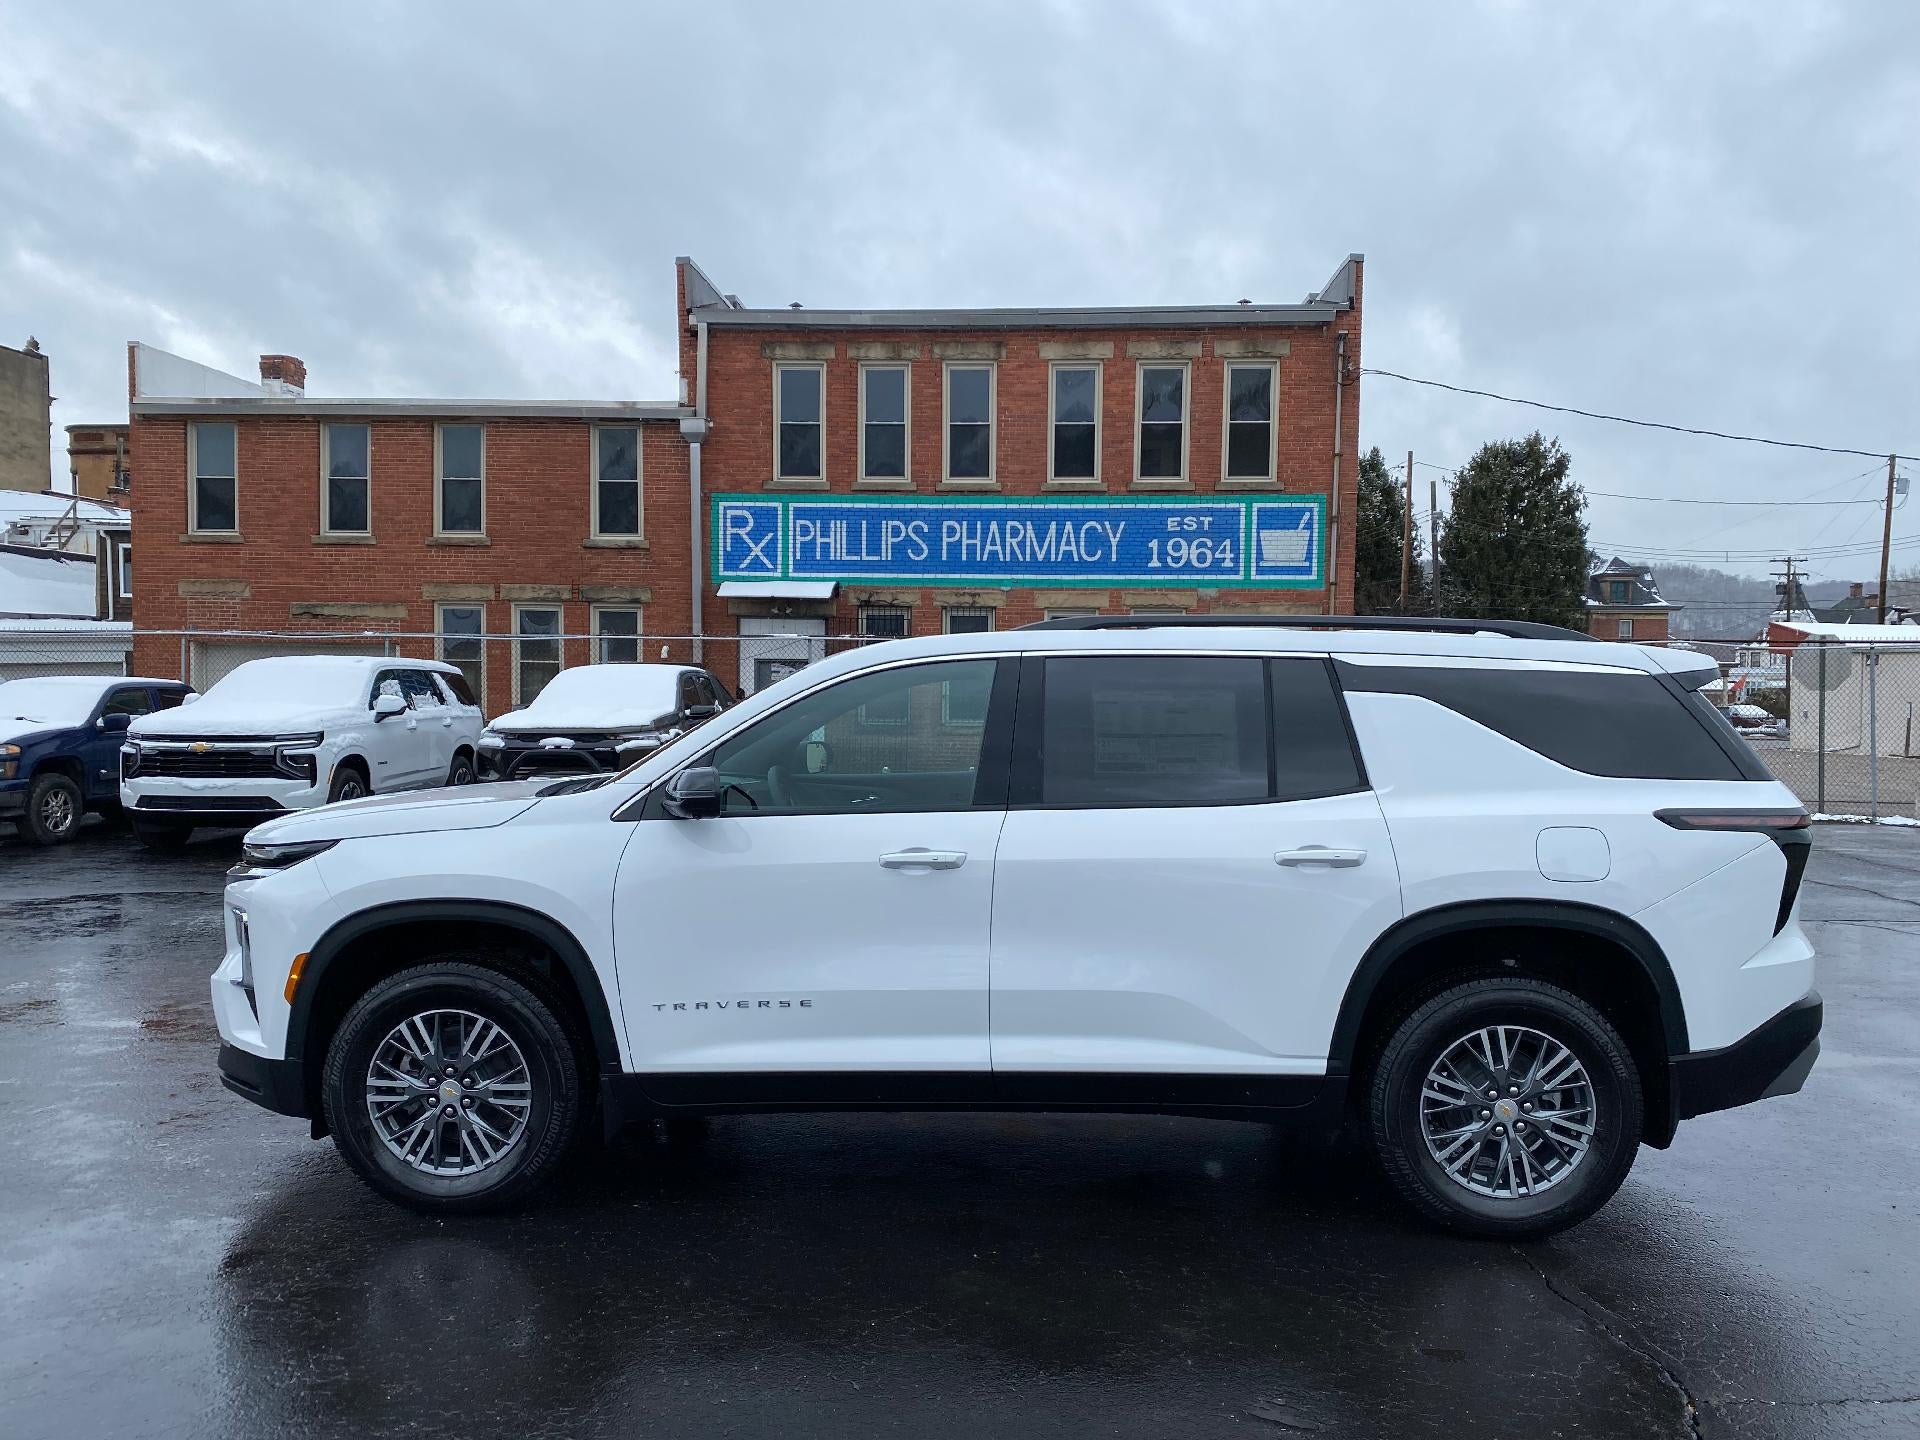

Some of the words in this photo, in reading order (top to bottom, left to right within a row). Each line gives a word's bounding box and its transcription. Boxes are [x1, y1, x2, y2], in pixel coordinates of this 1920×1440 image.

[1166, 516, 1213, 532] EST
[795, 519, 929, 561] PHILLIPS
[941, 520, 1126, 563] PHARMACY
[1147, 537, 1234, 568] 1964
[652, 999, 812, 1012] TRAVERSE
